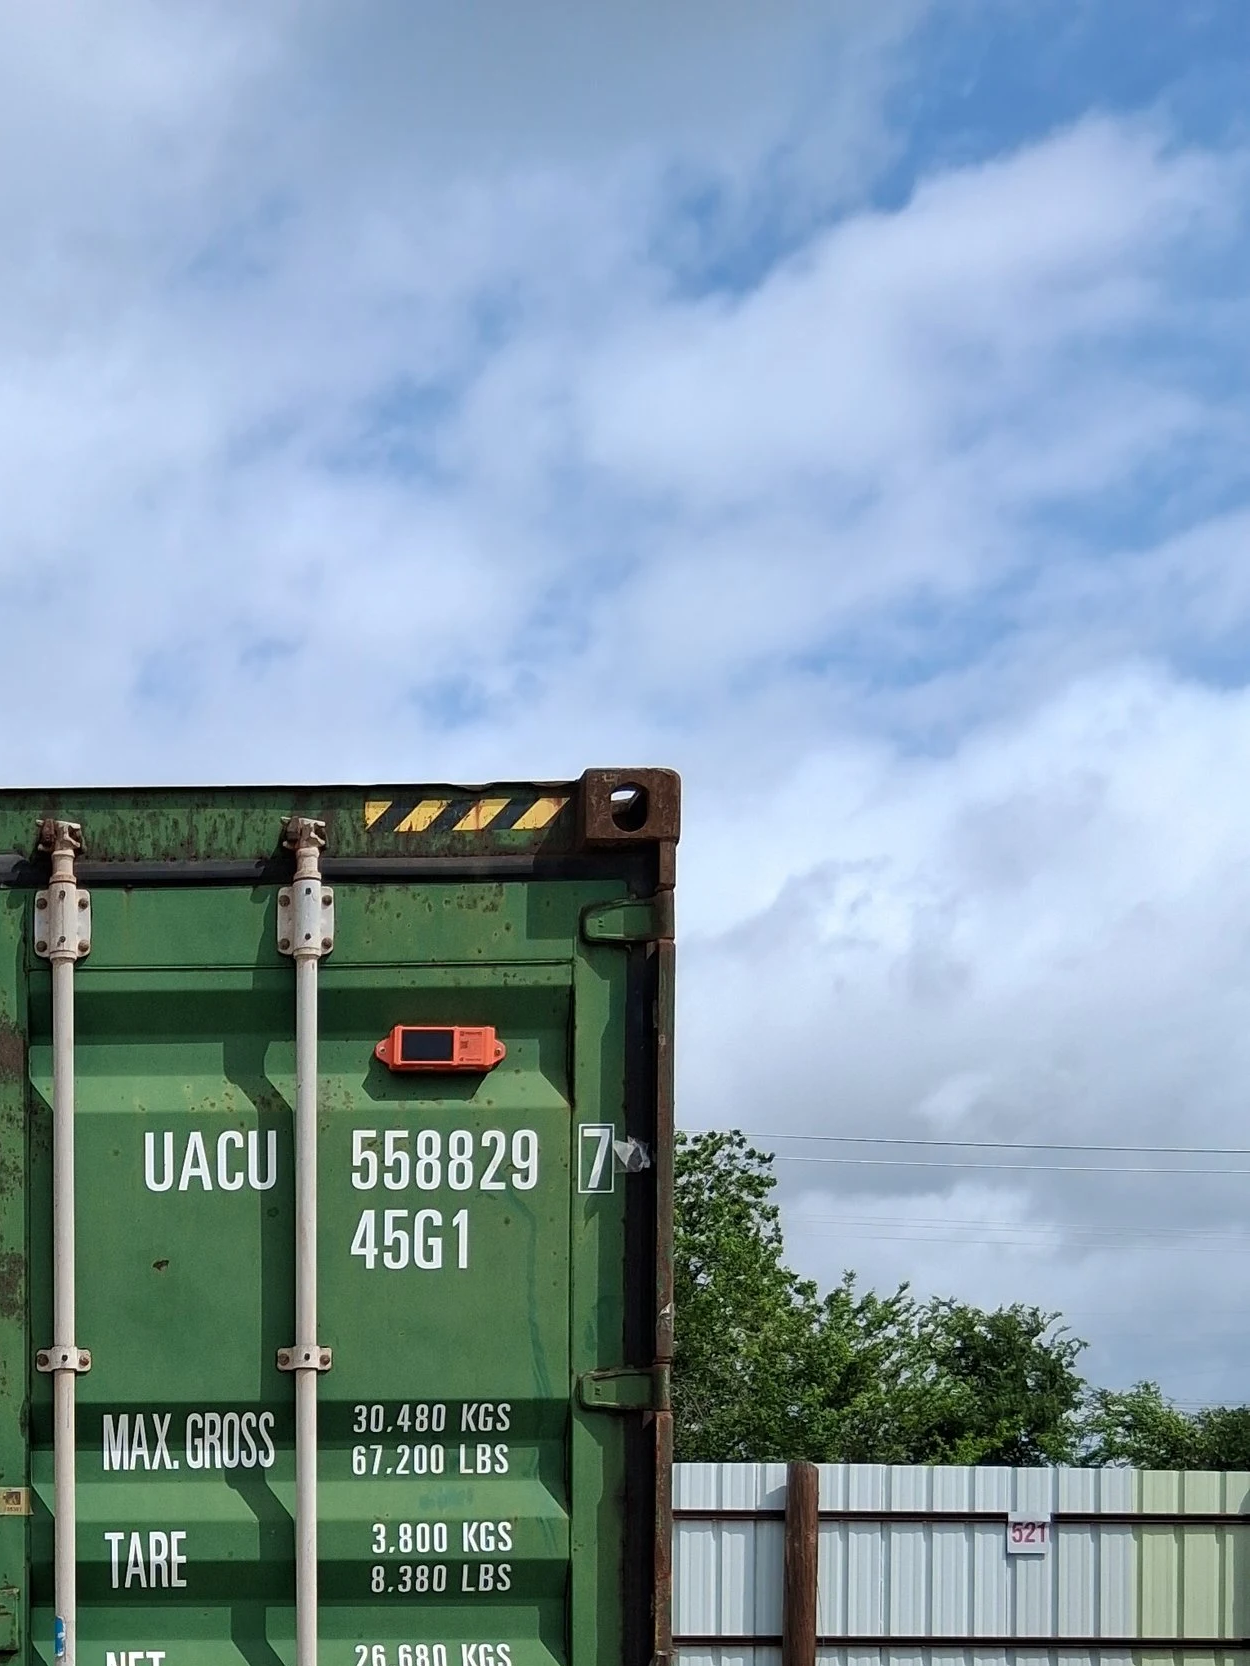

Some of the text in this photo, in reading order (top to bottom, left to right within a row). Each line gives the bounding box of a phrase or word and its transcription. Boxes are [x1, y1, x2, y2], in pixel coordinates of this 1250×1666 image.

[144, 1128, 610, 1192] UACU 558829 7
[350, 1209, 469, 1270] 45G1
[354, 1403, 512, 1433] 30,480 KGS
[103, 1411, 275, 1471] MAX. GROSS
[352, 1443, 509, 1475] 67,200 LBS
[372, 1521, 513, 1553] 3,800 KGS
[1012, 1522, 1045, 1543] 521
[105, 1531, 187, 1589] TARE
[371, 1563, 512, 1593] 8,380 LBS
